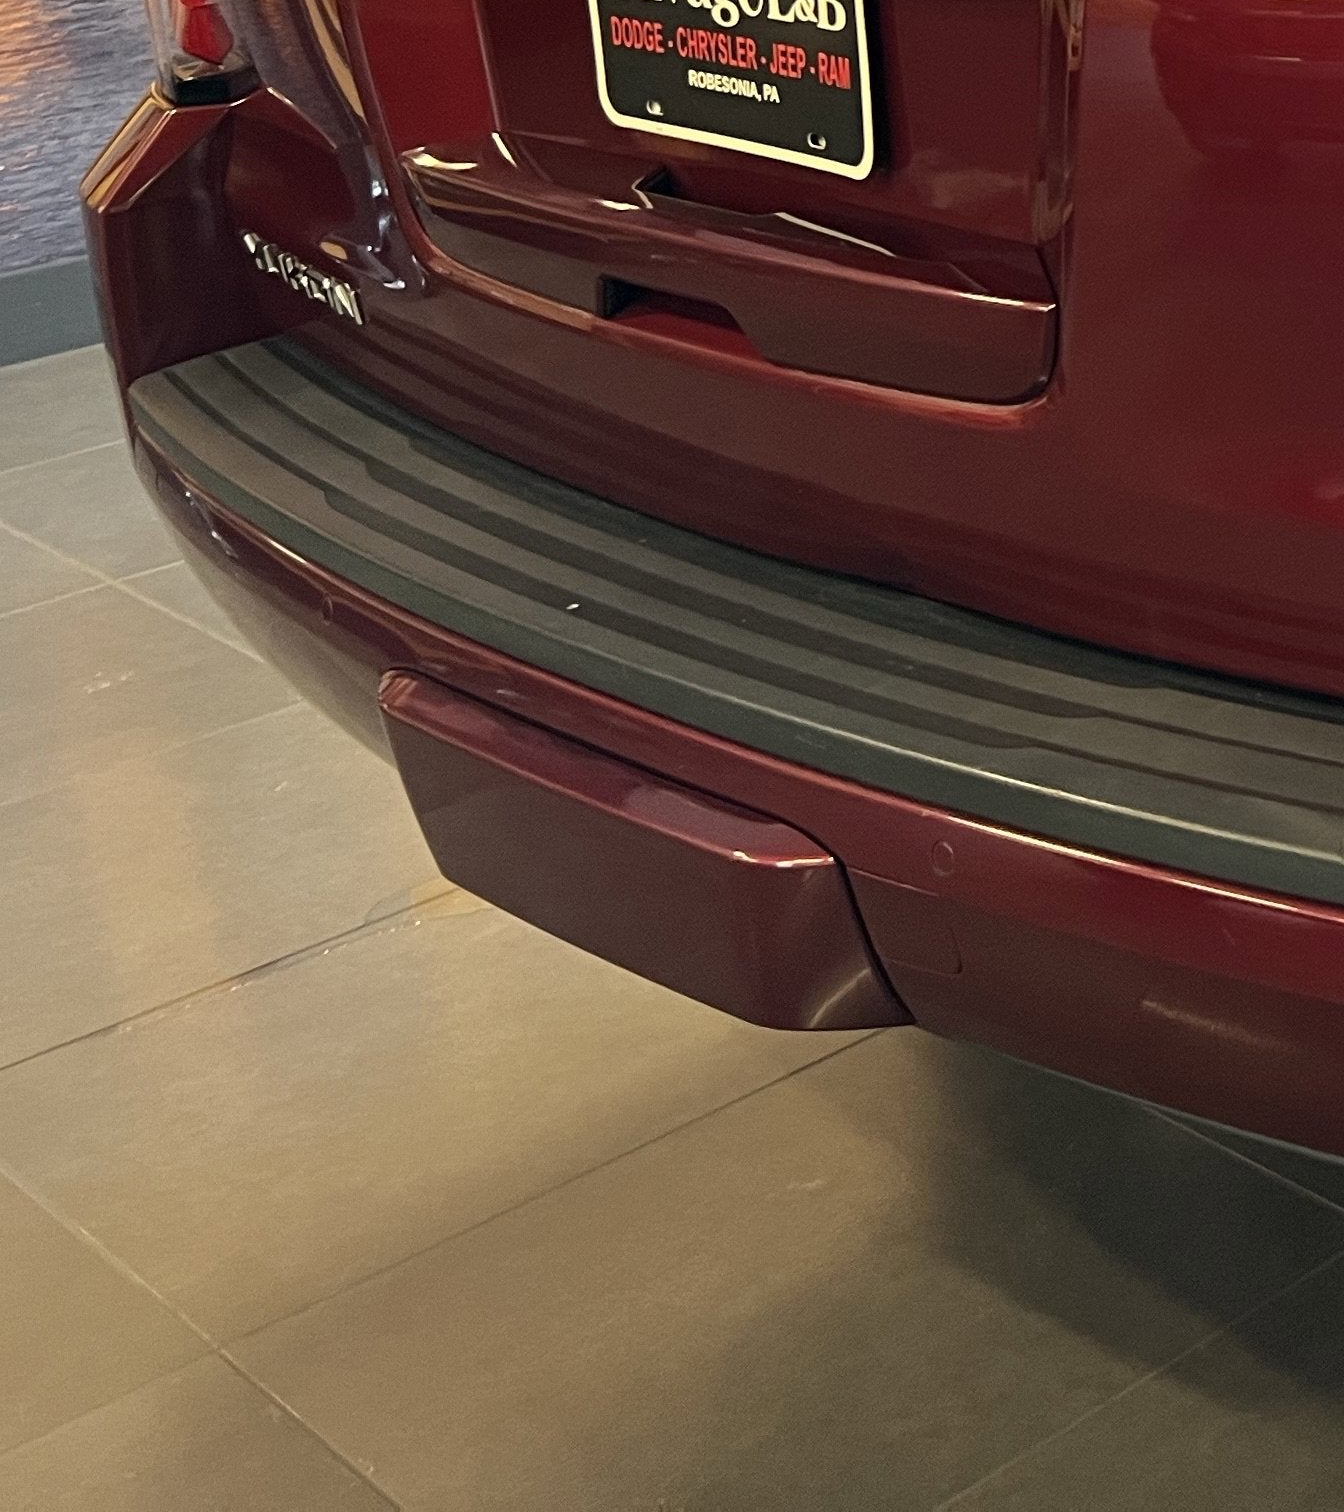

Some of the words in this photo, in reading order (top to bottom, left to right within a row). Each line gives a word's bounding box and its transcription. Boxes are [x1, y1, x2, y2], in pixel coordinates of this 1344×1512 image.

[611, 16, 665, 53] DODGE
[676, 27, 757, 70] CHRYSLER
[770, 43, 806, 78] JEEP
[818, 52, 851, 89] RAM
[763, 83, 780, 103] PA
